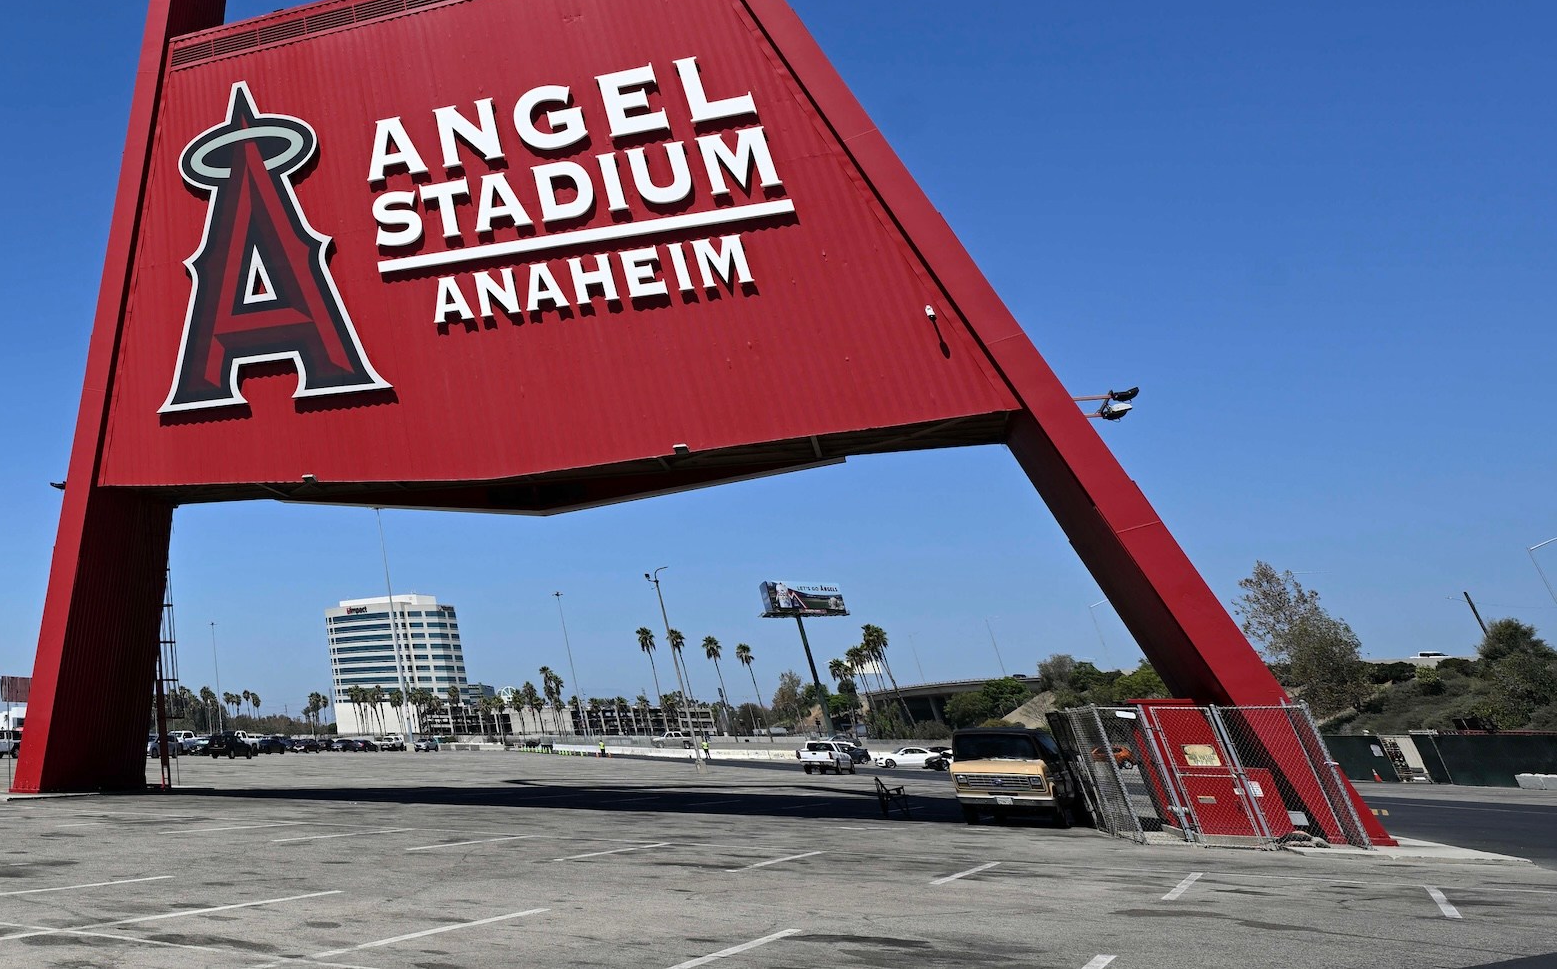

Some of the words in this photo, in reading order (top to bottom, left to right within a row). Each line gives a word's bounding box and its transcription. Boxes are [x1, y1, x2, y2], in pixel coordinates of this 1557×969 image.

[366, 56, 757, 182] ANGEL
[157, 80, 394, 414] A
[372, 125, 783, 247] STADIUM
[433, 234, 755, 324] ANAHEIM
